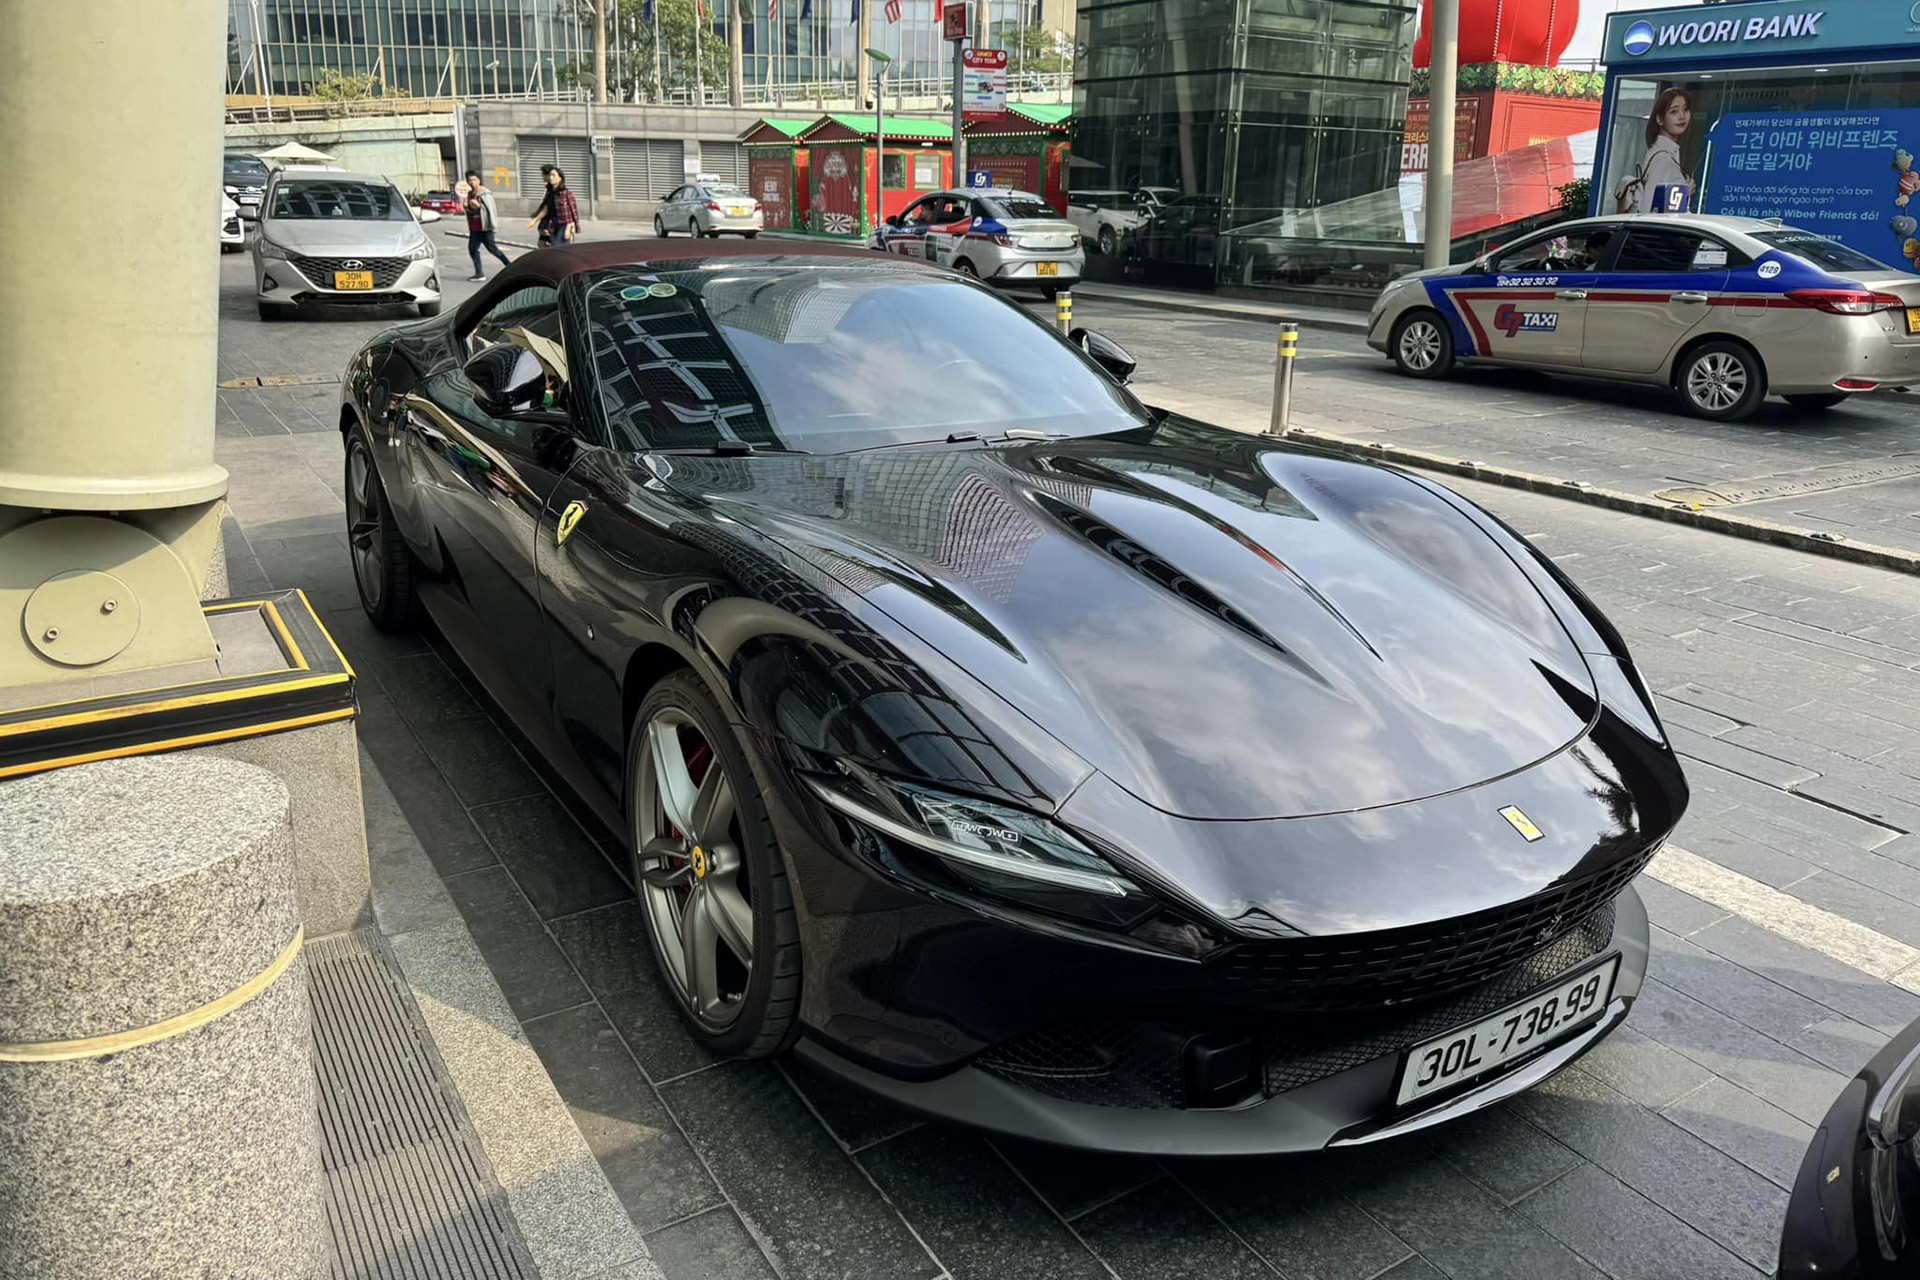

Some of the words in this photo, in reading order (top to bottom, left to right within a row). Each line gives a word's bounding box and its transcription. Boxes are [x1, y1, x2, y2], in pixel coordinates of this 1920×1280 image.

[1657, 18, 1741, 46] WOORI
[1744, 12, 1825, 40] BANK
[1771, 118, 1793, 127] 당신의
[1795, 117, 1831, 127] 금융생활이
[1833, 116, 1880, 126] 달달해졌다면
[1403, 132, 1429, 143] 크리스
[1732, 131, 1765, 149] 그건
[1770, 131, 1804, 149] 아마
[1807, 130, 1898, 149] 위비프렌즈
[1729, 152, 1813, 171] 때문일거야
[1724, 185, 1733, 193] Từ
[1734, 185, 1745, 193] khi
[1746, 185, 1762, 193] nào
[1778, 185, 1798, 195] sống
[1836, 186, 1854, 195] của
[1855, 186, 1873, 196] bạn
[1721, 207, 1734, 216] Có
[1749, 207, 1759, 217] là
[1784, 209, 1816, 219] Wibee
[1819, 210, 1857, 220] Friends
[1860, 211, 1879, 220] đó!
[345, 272, 361, 280] 30H
[1545, 276, 1559, 286] 32
[1523, 313, 1557, 326] TAXI
[1417, 974, 1601, 1087] 30L-738.99
